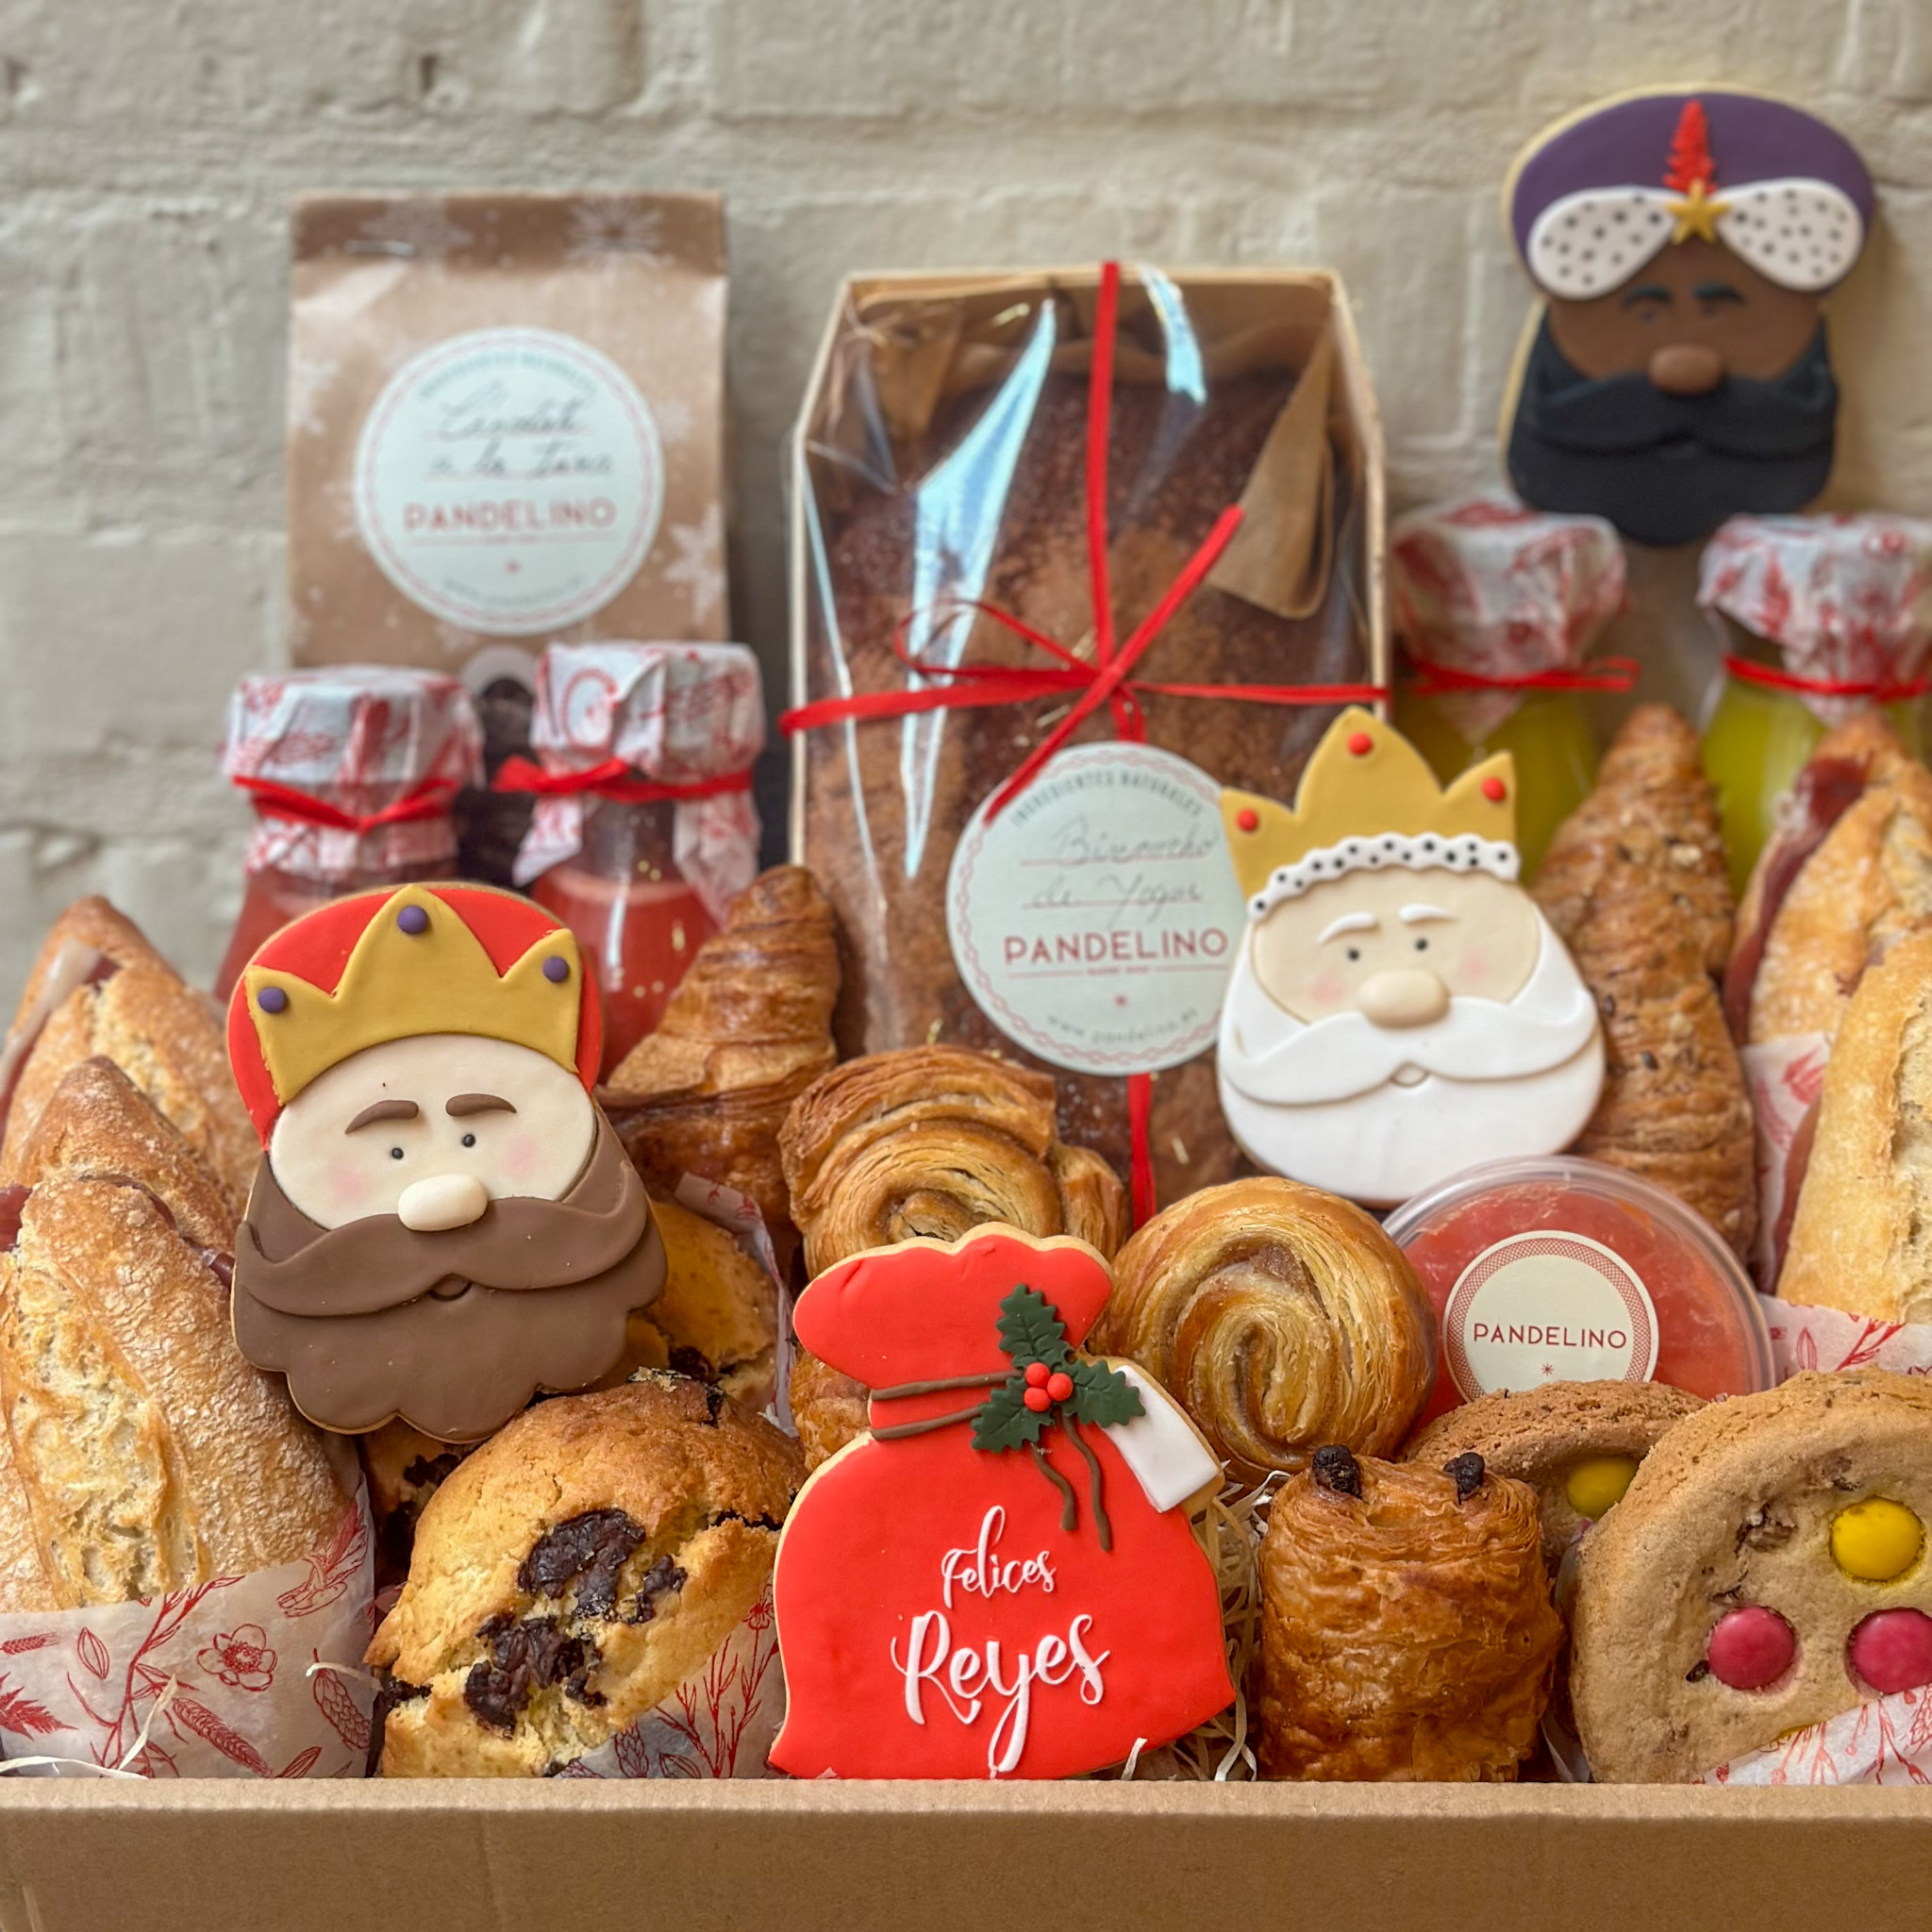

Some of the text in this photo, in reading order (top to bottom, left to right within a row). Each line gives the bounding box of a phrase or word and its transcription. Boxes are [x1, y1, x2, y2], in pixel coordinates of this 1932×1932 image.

[403, 497, 617, 531] PANDELINO
[1004, 927, 1228, 965] PANDELINO
[1474, 1323, 1627, 1349] PANDELINO
[941, 1505, 1057, 1609] Felices
[891, 1609, 1111, 1774] Reyes
